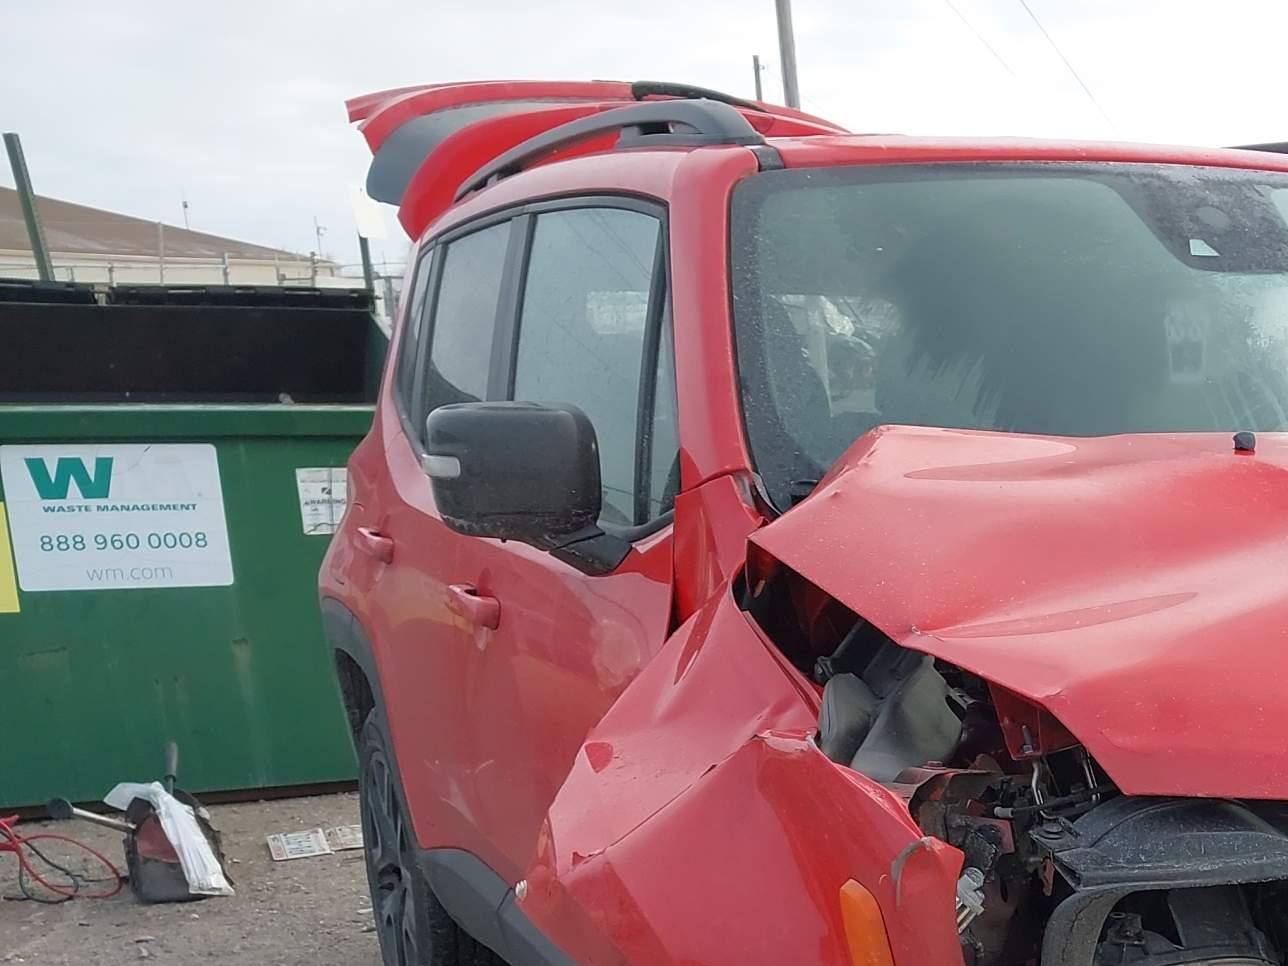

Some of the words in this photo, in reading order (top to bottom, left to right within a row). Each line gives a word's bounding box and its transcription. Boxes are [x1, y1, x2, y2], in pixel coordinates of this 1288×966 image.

[42, 504, 93, 513] WASTE
[96, 503, 198, 512] MANAGEMENT
[40, 534, 86, 552] 888
[94, 533, 140, 551] 960
[147, 531, 208, 550] 0008
[86, 565, 174, 582] wm.com
